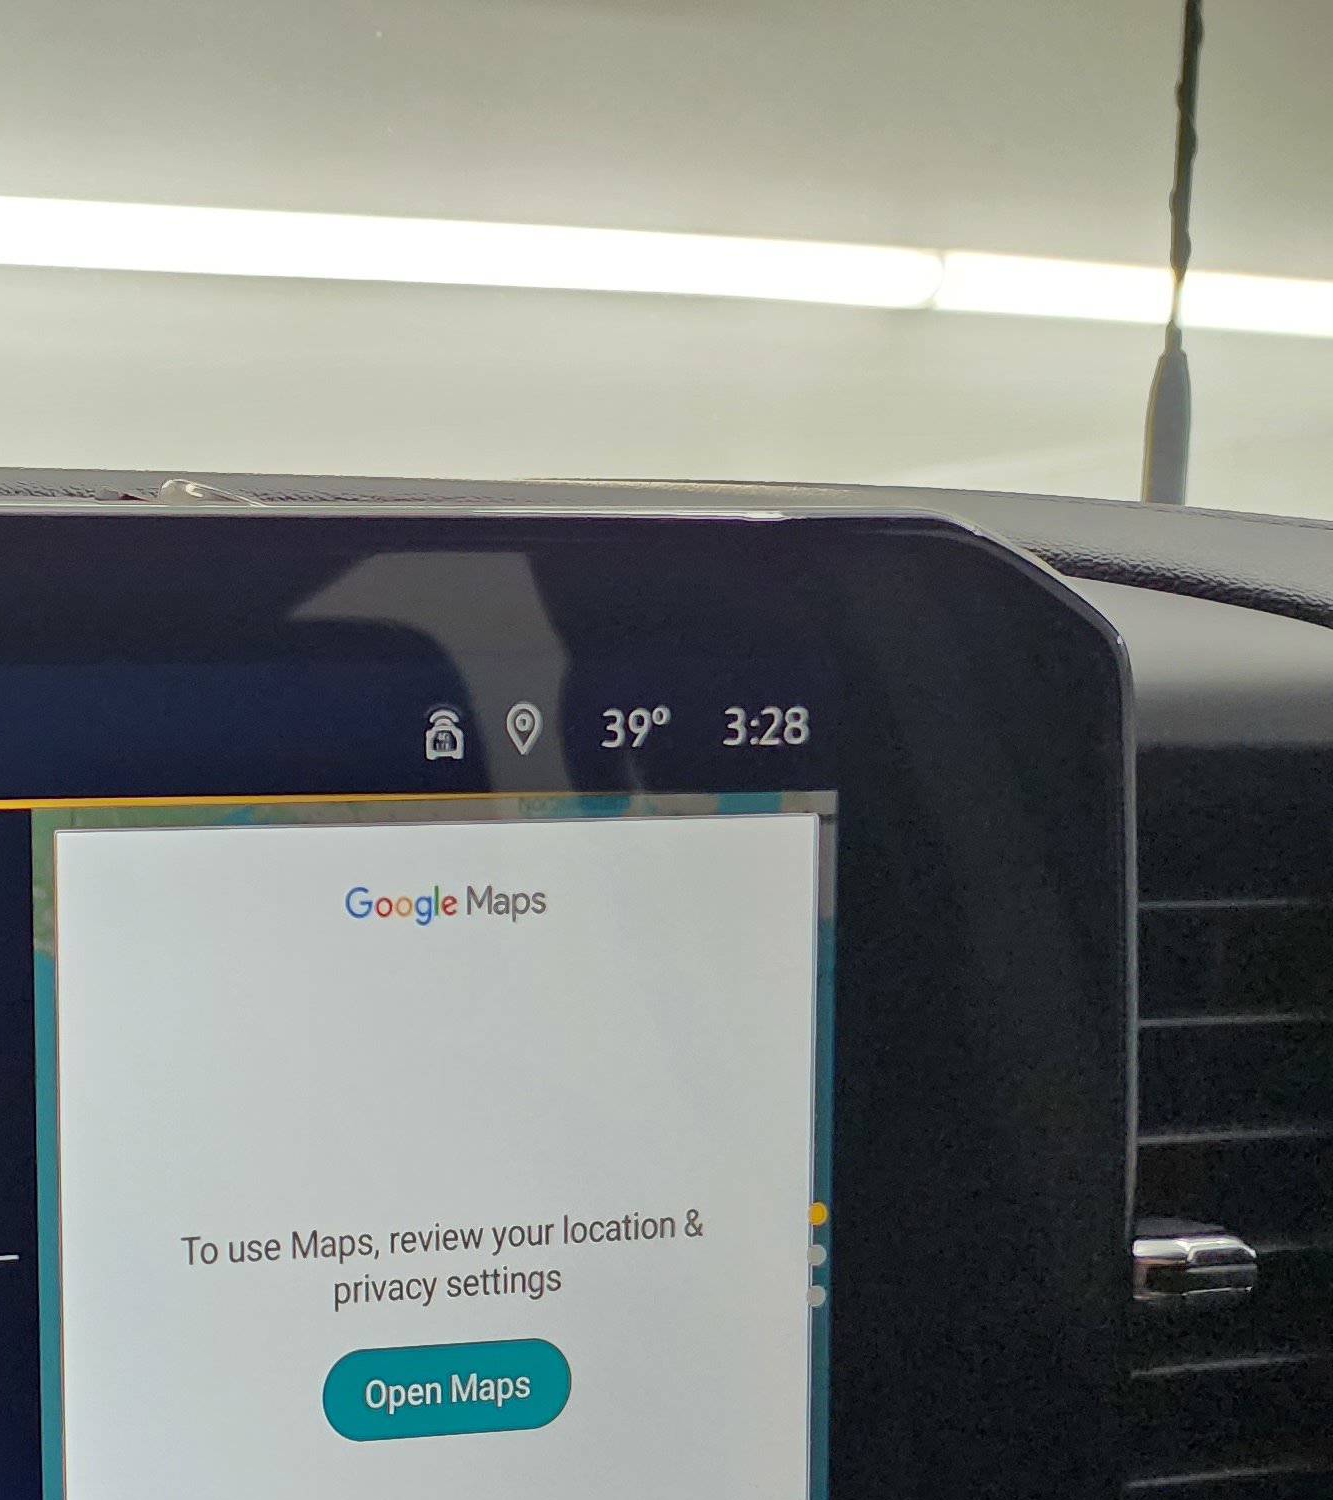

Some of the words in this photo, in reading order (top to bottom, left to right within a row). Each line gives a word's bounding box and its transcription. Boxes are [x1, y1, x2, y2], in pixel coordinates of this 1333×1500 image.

[723, 706, 808, 745] 3:28
[346, 886, 457, 925] Google
[467, 886, 546, 922] Maps
[181, 1237, 218, 1265] To
[229, 1239, 281, 1263] use
[292, 1230, 379, 1264] Maps,
[391, 1223, 483, 1253] review
[492, 1224, 554, 1256] your
[564, 1212, 675, 1244] location
[685, 1209, 703, 1237] &
[335, 1274, 437, 1312] privacy
[447, 1266, 561, 1300] settings
[366, 1380, 441, 1414] Open
[452, 1373, 530, 1407] Maps
